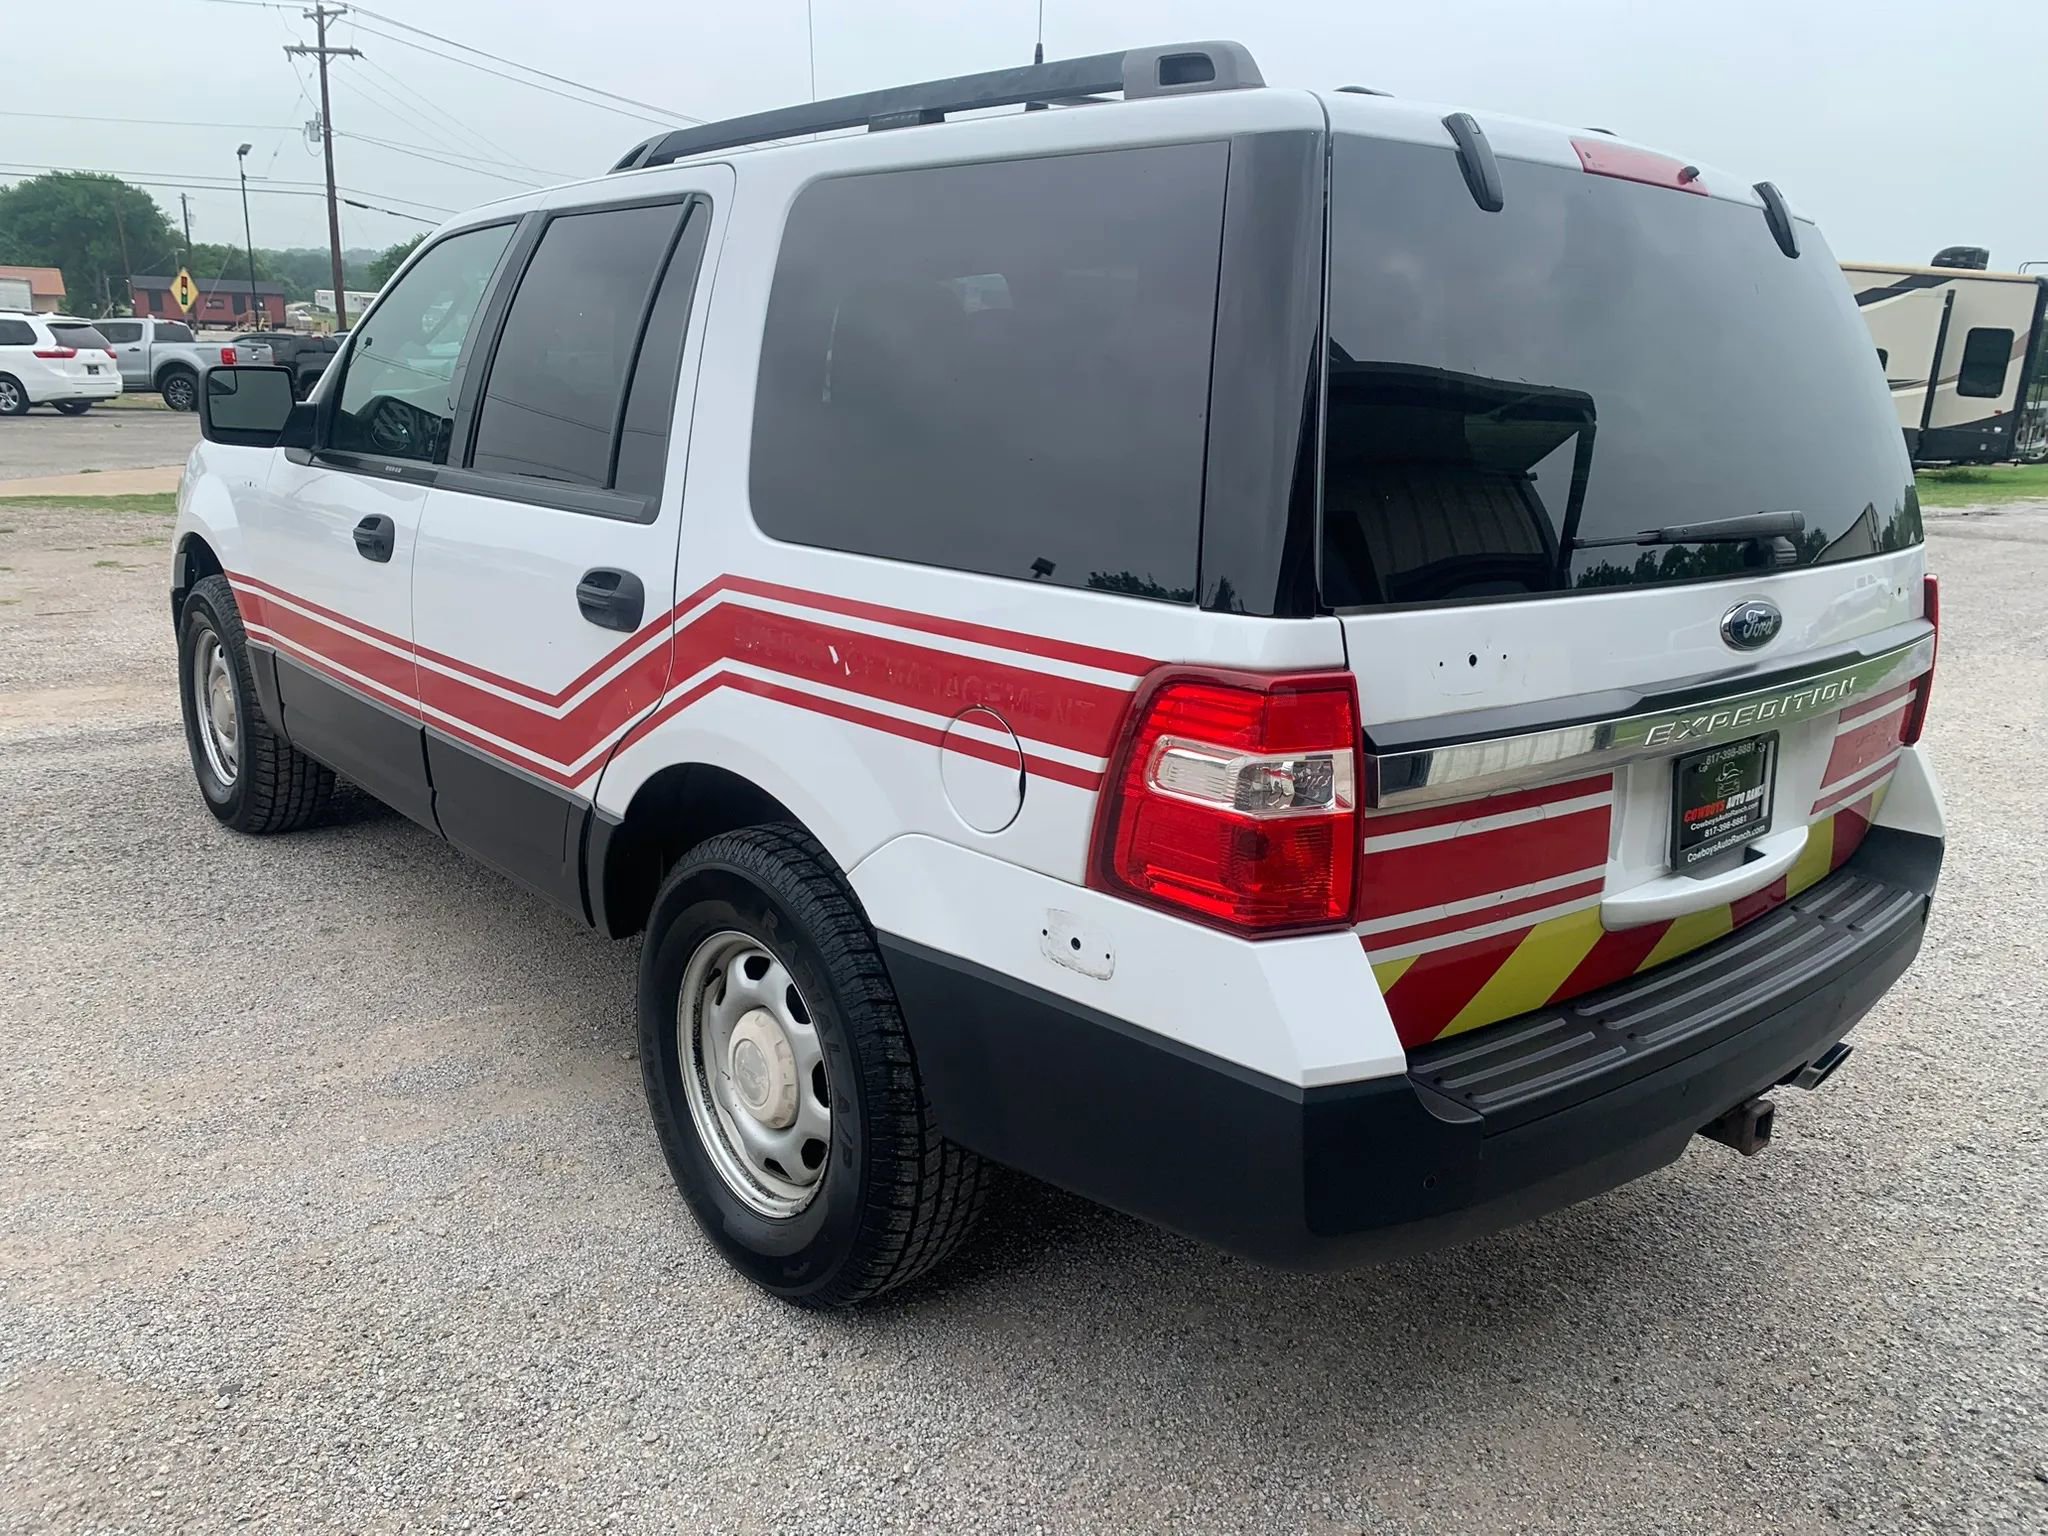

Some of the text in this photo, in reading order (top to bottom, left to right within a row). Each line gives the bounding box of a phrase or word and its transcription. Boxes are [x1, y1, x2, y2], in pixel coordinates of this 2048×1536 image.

[1742, 610, 1775, 639] Ford
[1643, 676, 1857, 748] EXPEDITION
[1684, 784, 1766, 823] COWBOYS AUTO RANC
[1687, 825, 1766, 863] CowboysAutoRanch.com
